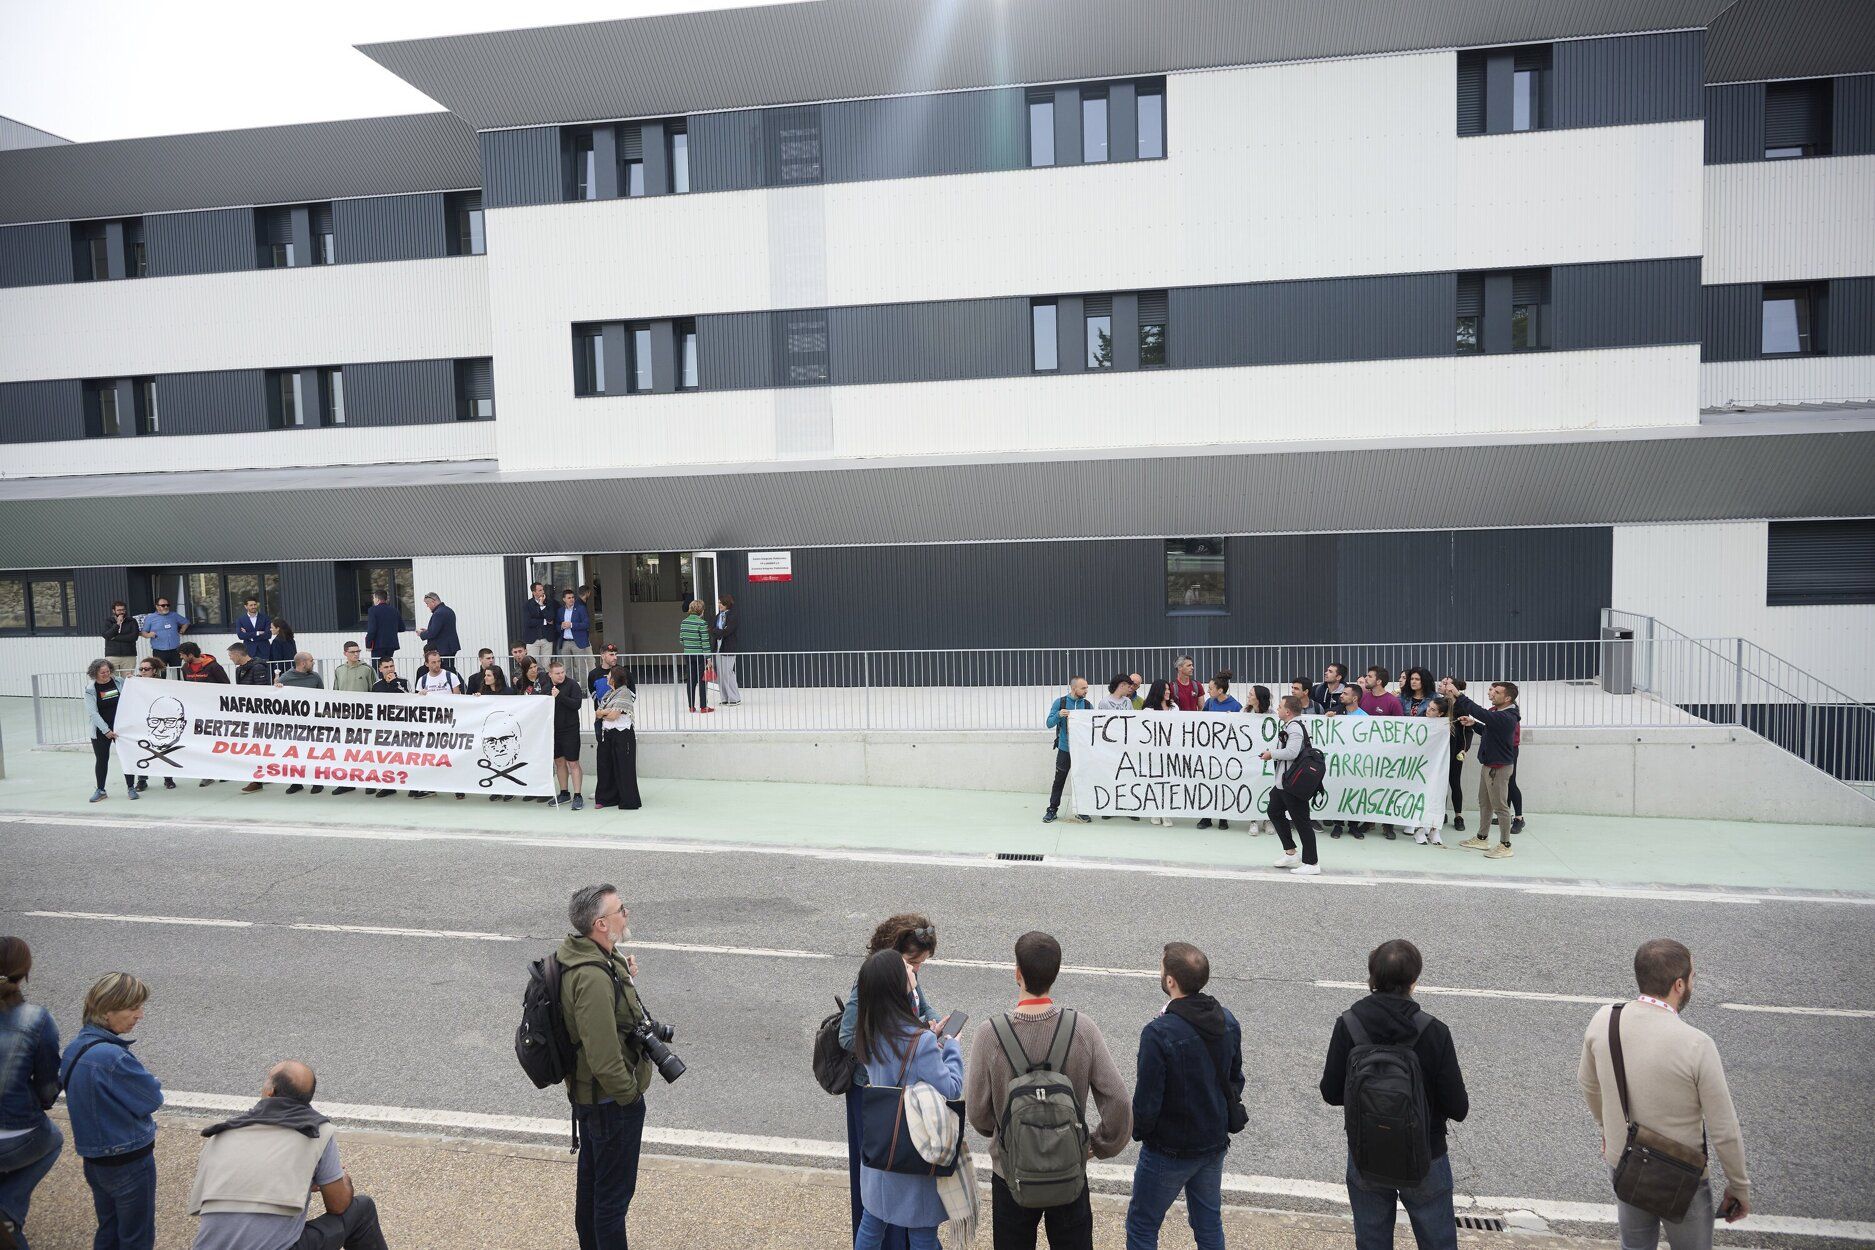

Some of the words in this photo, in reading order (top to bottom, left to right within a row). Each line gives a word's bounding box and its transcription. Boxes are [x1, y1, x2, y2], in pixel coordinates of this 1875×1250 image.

[219, 695, 311, 718] NAFARROAKO
[314, 701, 373, 721] LANBIDE
[377, 704, 457, 728] HEZIKETAN,
[193, 718, 250, 738] BERTZE
[252, 721, 341, 743] MURRIZKETA
[344, 727, 373, 745] BAT
[374, 729, 425, 748] EZARRI
[425, 731, 475, 750] DIGUTE
[1091, 715, 1137, 746] FCT
[1139, 719, 1173, 747] SIN
[1182, 720, 1253, 752] HORAS
[1352, 719, 1428, 747] GABEKO
[211, 740, 276, 757] DUAL
[282, 745, 299, 759] A
[306, 746, 336, 761] LA
[343, 748, 453, 768] NAVARRA
[1115, 751, 1243, 781] ALUMNADO
[1323, 752, 1429, 784] ARRAIPENIK
[252, 762, 307, 779] ¿SIN
[313, 764, 409, 785] HORAS?
[1094, 781, 1253, 814] DESATENDIDO
[1337, 787, 1426, 821] IKASLEGOA
